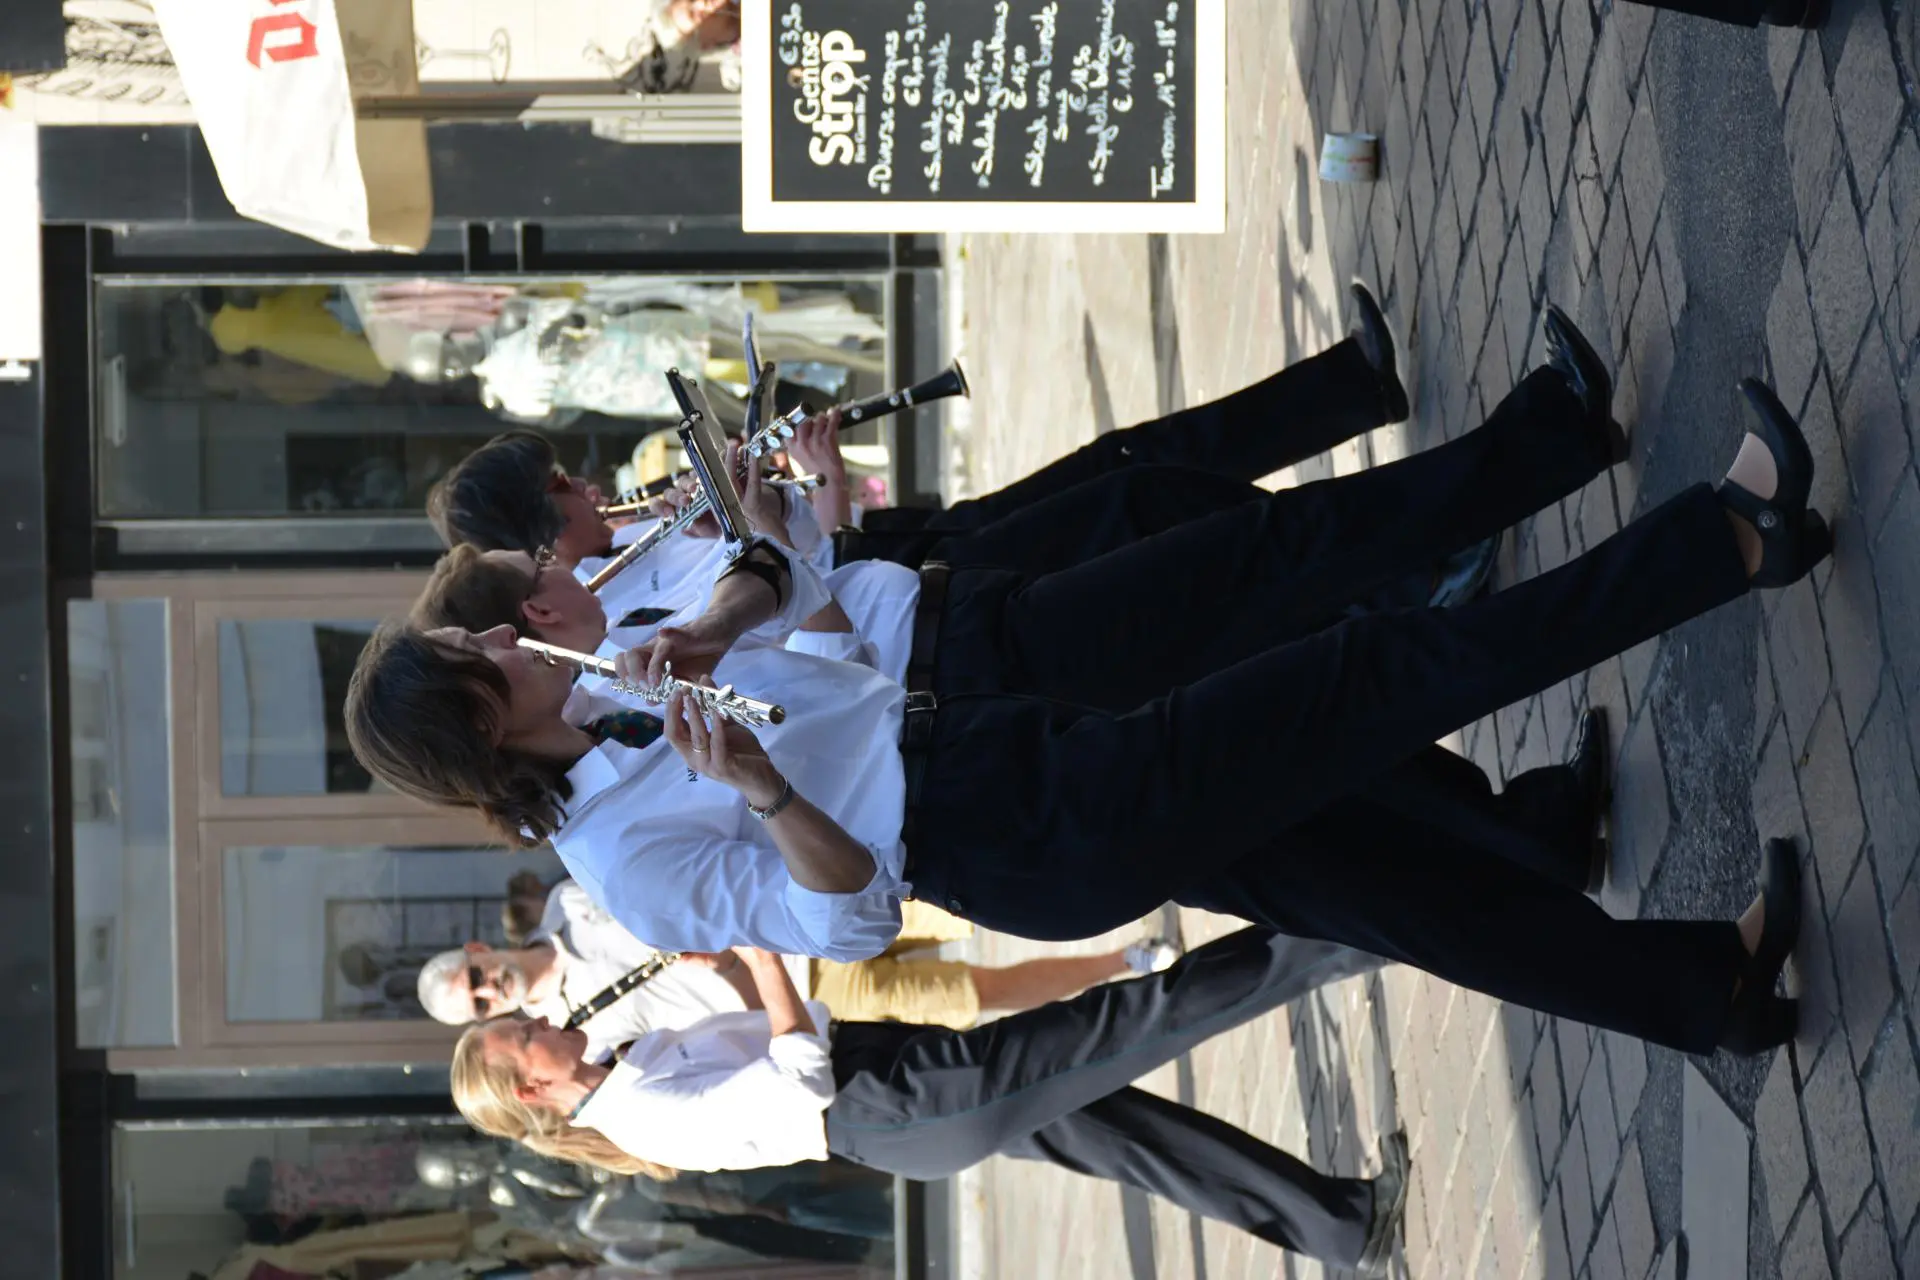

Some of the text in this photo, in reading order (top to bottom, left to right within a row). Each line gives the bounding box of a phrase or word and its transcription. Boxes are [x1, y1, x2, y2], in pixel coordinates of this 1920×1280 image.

[245, 0, 320, 69] D
[793, 31, 820, 123] Gentse
[808, 30, 867, 166] Strop
